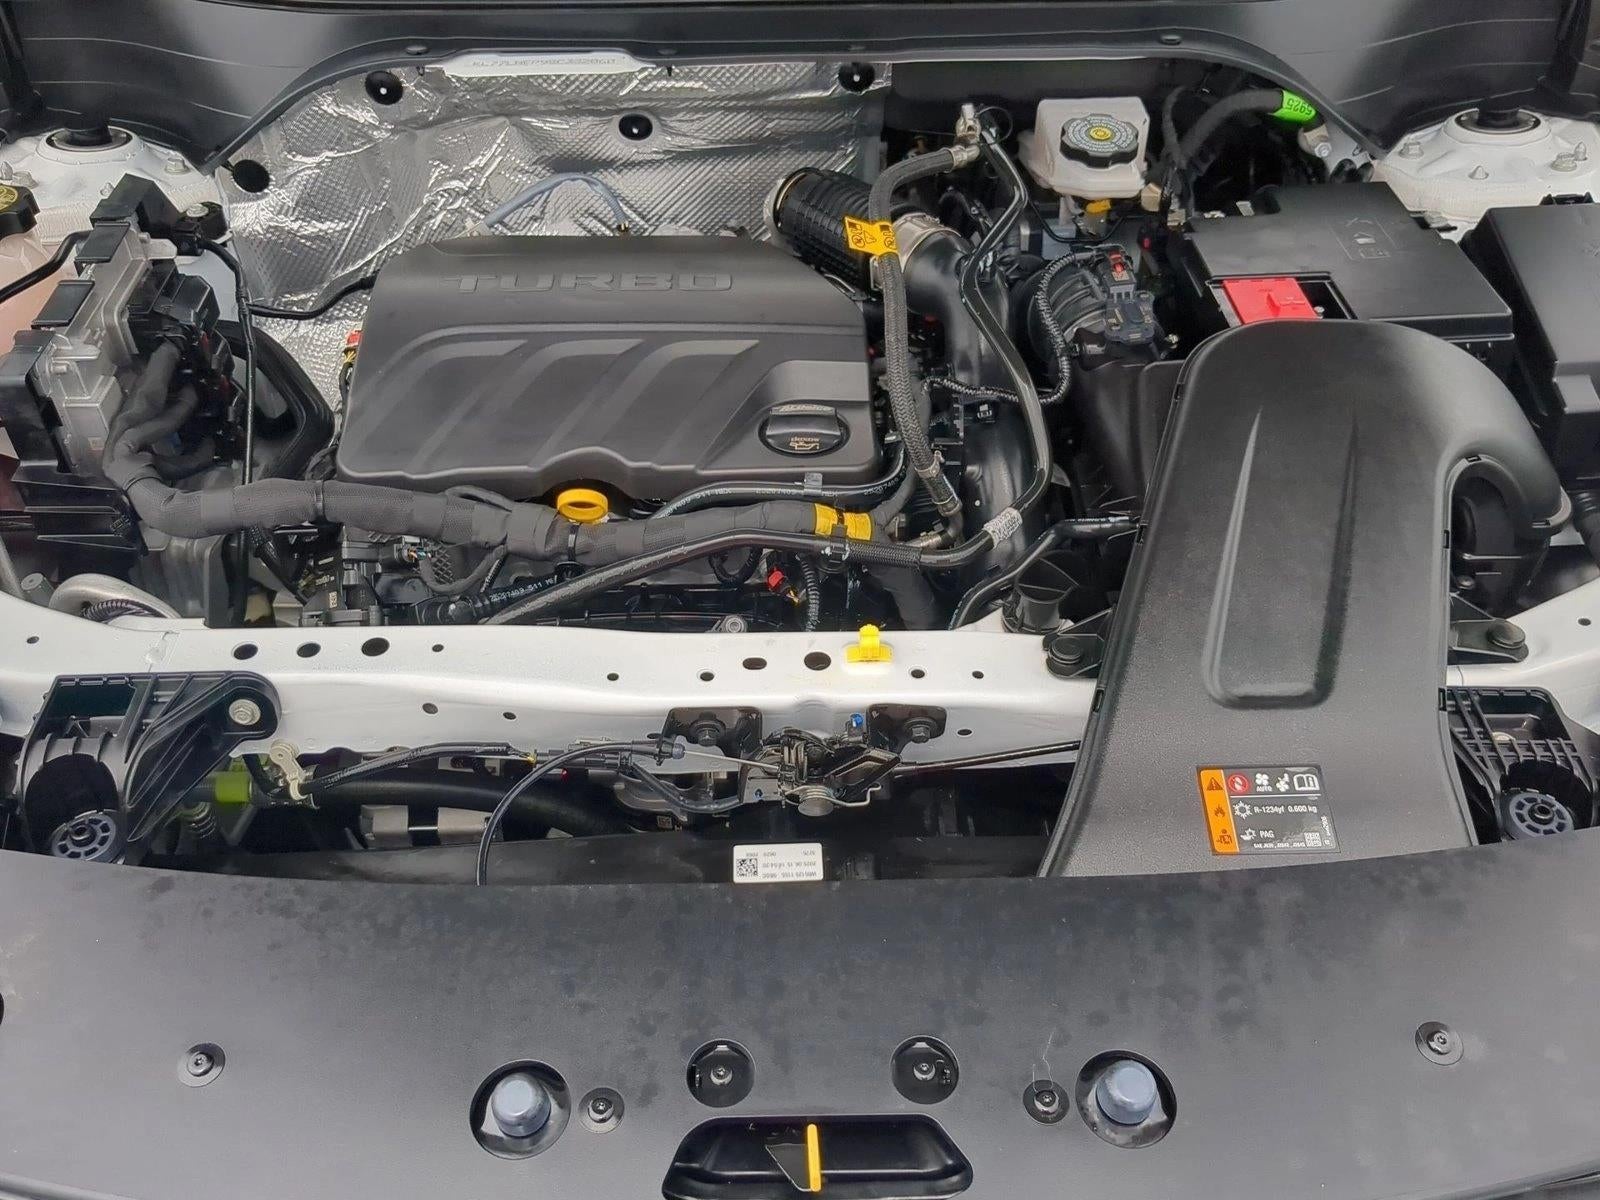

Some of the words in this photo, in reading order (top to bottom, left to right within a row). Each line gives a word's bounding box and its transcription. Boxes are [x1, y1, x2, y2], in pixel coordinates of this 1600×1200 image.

[443, 272, 734, 294] TURBO
[1253, 805, 1286, 815] R-1234yf
[1287, 804, 1307, 813] 0.600
[1308, 804, 1318, 813] kg
[1259, 830, 1275, 839] PAG
